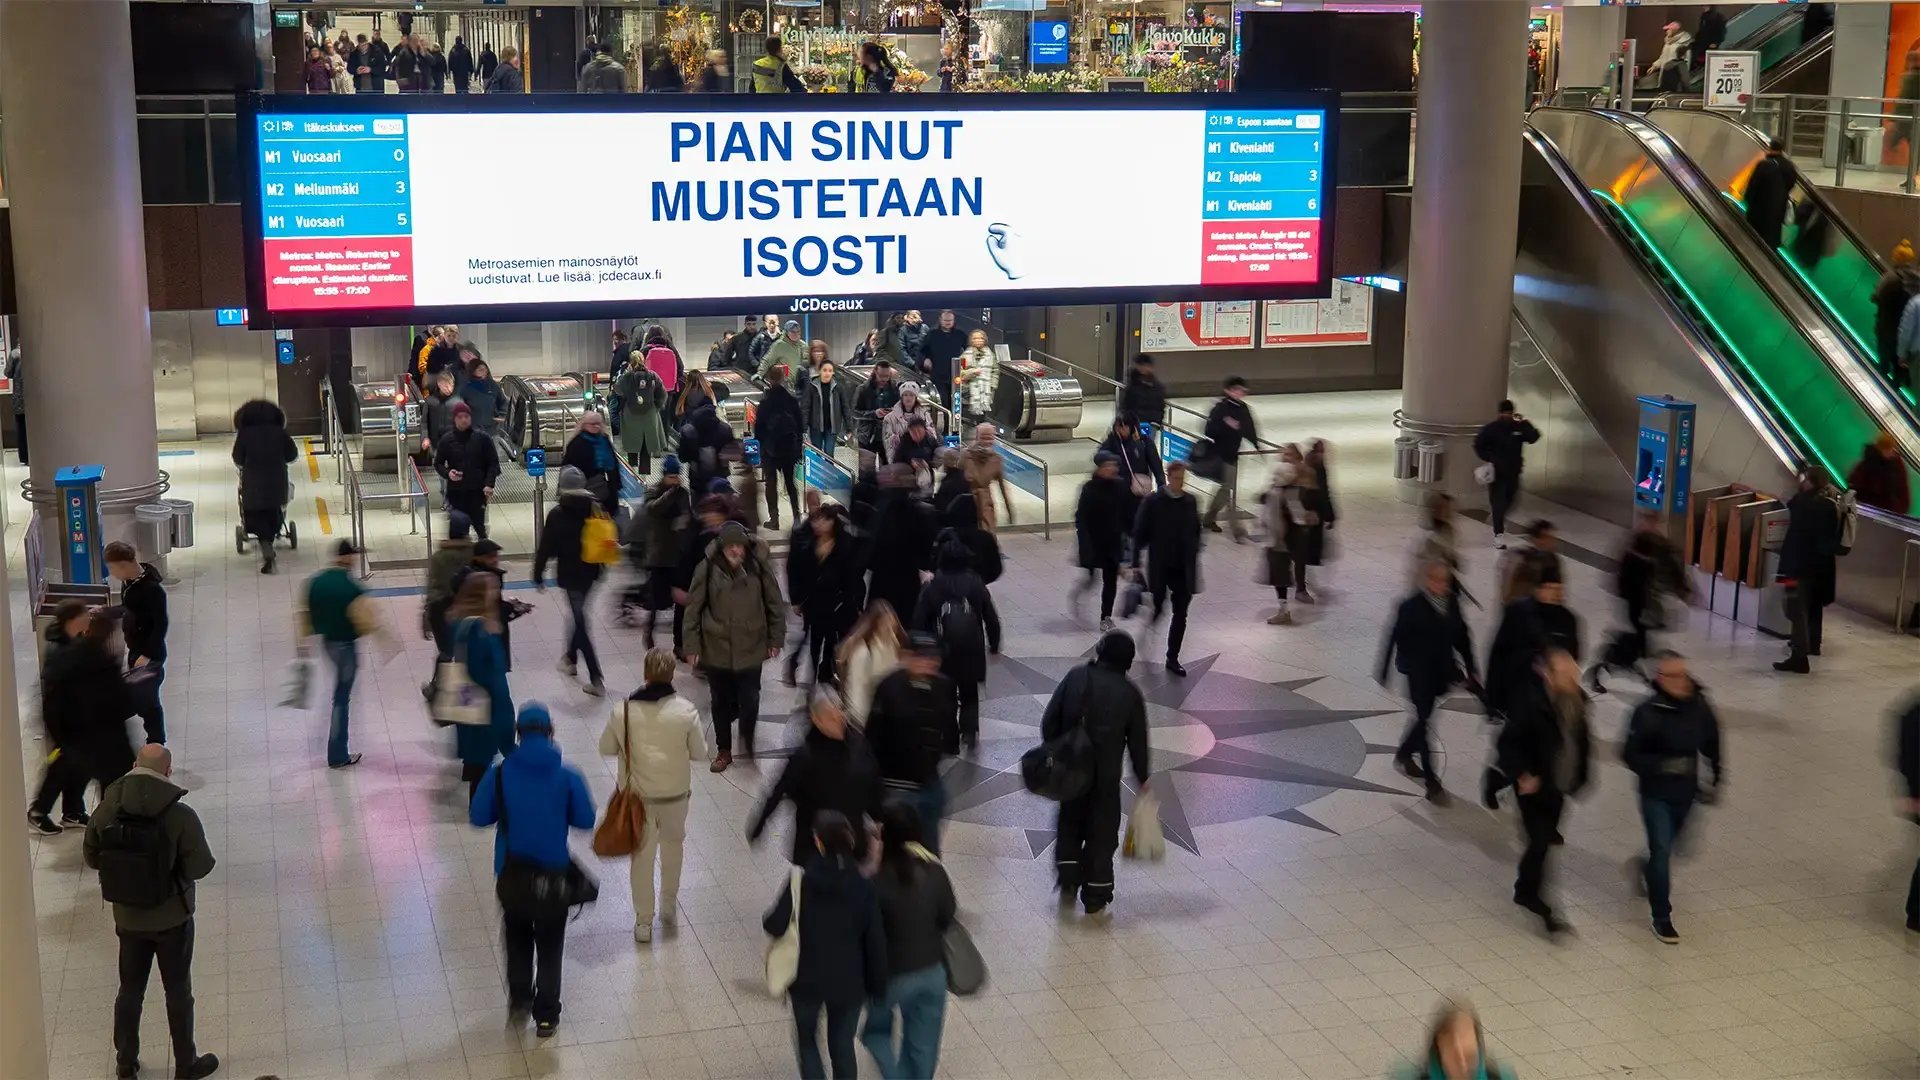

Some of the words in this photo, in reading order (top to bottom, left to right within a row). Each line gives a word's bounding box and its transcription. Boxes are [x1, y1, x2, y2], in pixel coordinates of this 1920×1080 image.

[1716, 78, 1733, 94] 20
[671, 121, 791, 162] PIAN
[811, 120, 963, 161] SINUT
[1208, 142, 1220, 153] M1
[1230, 142, 1274, 153] Kivenlahti
[1313, 141, 1319, 152] 1
[265, 151, 280, 163] M1
[292, 150, 341, 162] Vuosaari
[394, 149, 404, 161] 0
[1208, 171, 1221, 182] M2
[1229, 171, 1261, 184] Tapiola
[1310, 170, 1317, 181] 3
[267, 184, 284, 196] M2
[295, 183, 358, 195] Mellunmäki
[396, 181, 405, 193] 3
[652, 177, 982, 221] MUISTETAAN
[1206, 201, 1219, 211] M1
[1228, 200, 1272, 211] Kivenlahti
[1308, 199, 1316, 209] 6
[269, 216, 284, 228] M1
[296, 216, 344, 227] Vuosaari
[398, 214, 407, 225] 5
[469, 257, 554, 269] Metroasemien
[559, 255, 638, 269] mainosnäytöt
[744, 235, 906, 277] ISOSTI
[469, 273, 534, 284] uudistuvat.
[538, 272, 560, 282] Lue
[564, 271, 594, 282] lisää:
[599, 267, 661, 284] jcdecaux.fi
[791, 298, 863, 311] JCDecaux
